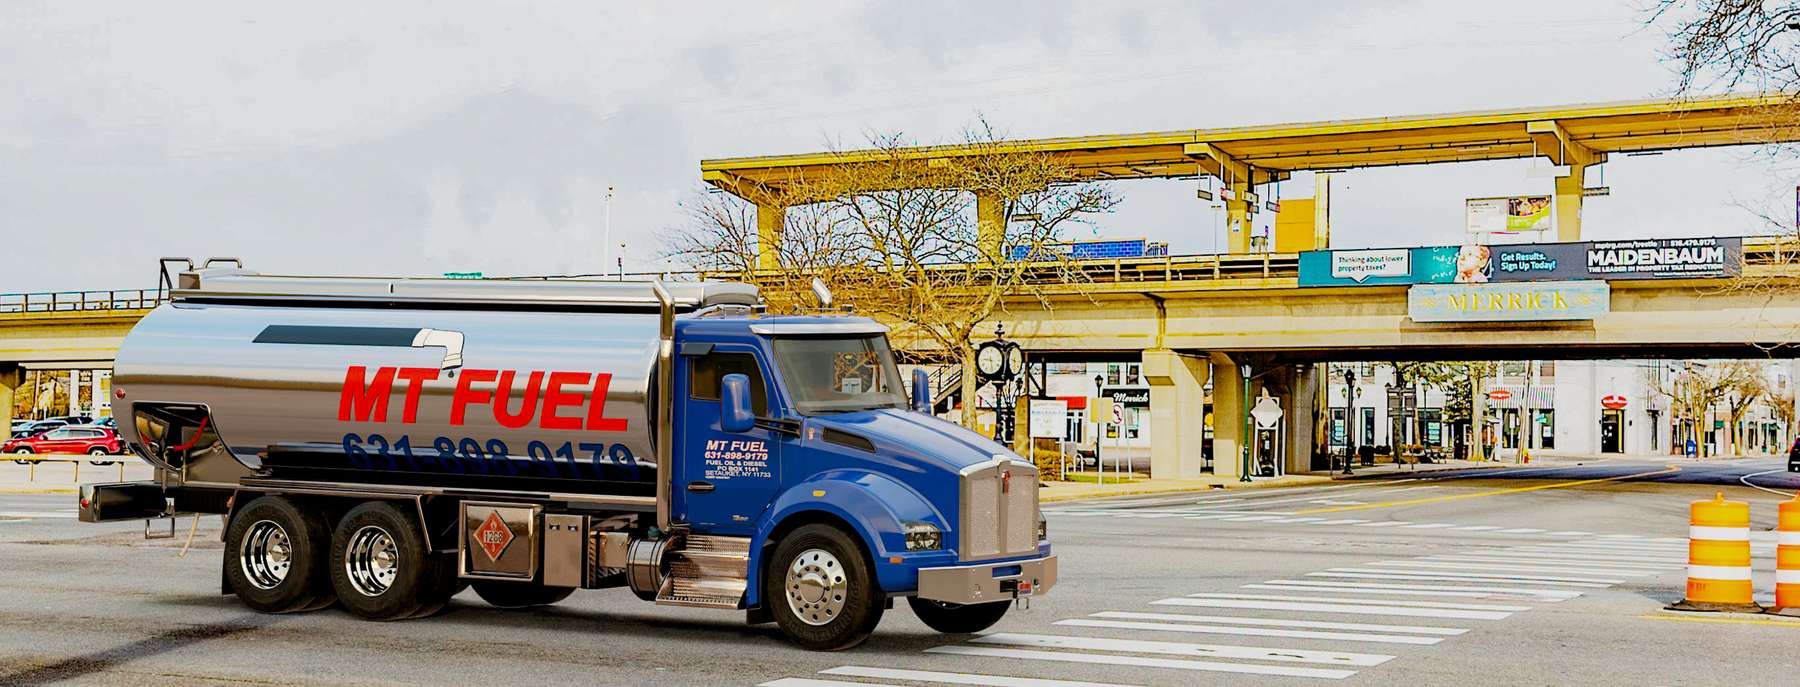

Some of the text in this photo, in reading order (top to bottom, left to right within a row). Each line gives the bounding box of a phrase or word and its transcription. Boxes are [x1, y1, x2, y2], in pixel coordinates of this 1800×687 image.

[1338, 256, 1365, 264] Thinking
[1500, 252, 1547, 262] Get Results.
[1587, 247, 1724, 266] MAIDENBAUM
[1365, 263, 1386, 271] taxes?
[1500, 259, 1556, 272] Sign Up Today!
[1684, 263, 1724, 271] REDUCTION
[1449, 289, 1569, 312] MERRICK
[337, 365, 629, 432] MT FUEL
[1113, 391, 1149, 403] Merrick
[706, 439, 769, 452] MT FUEL
[342, 432, 639, 481] 631-898-9179
[704, 451, 768, 461] 631-898-9179
